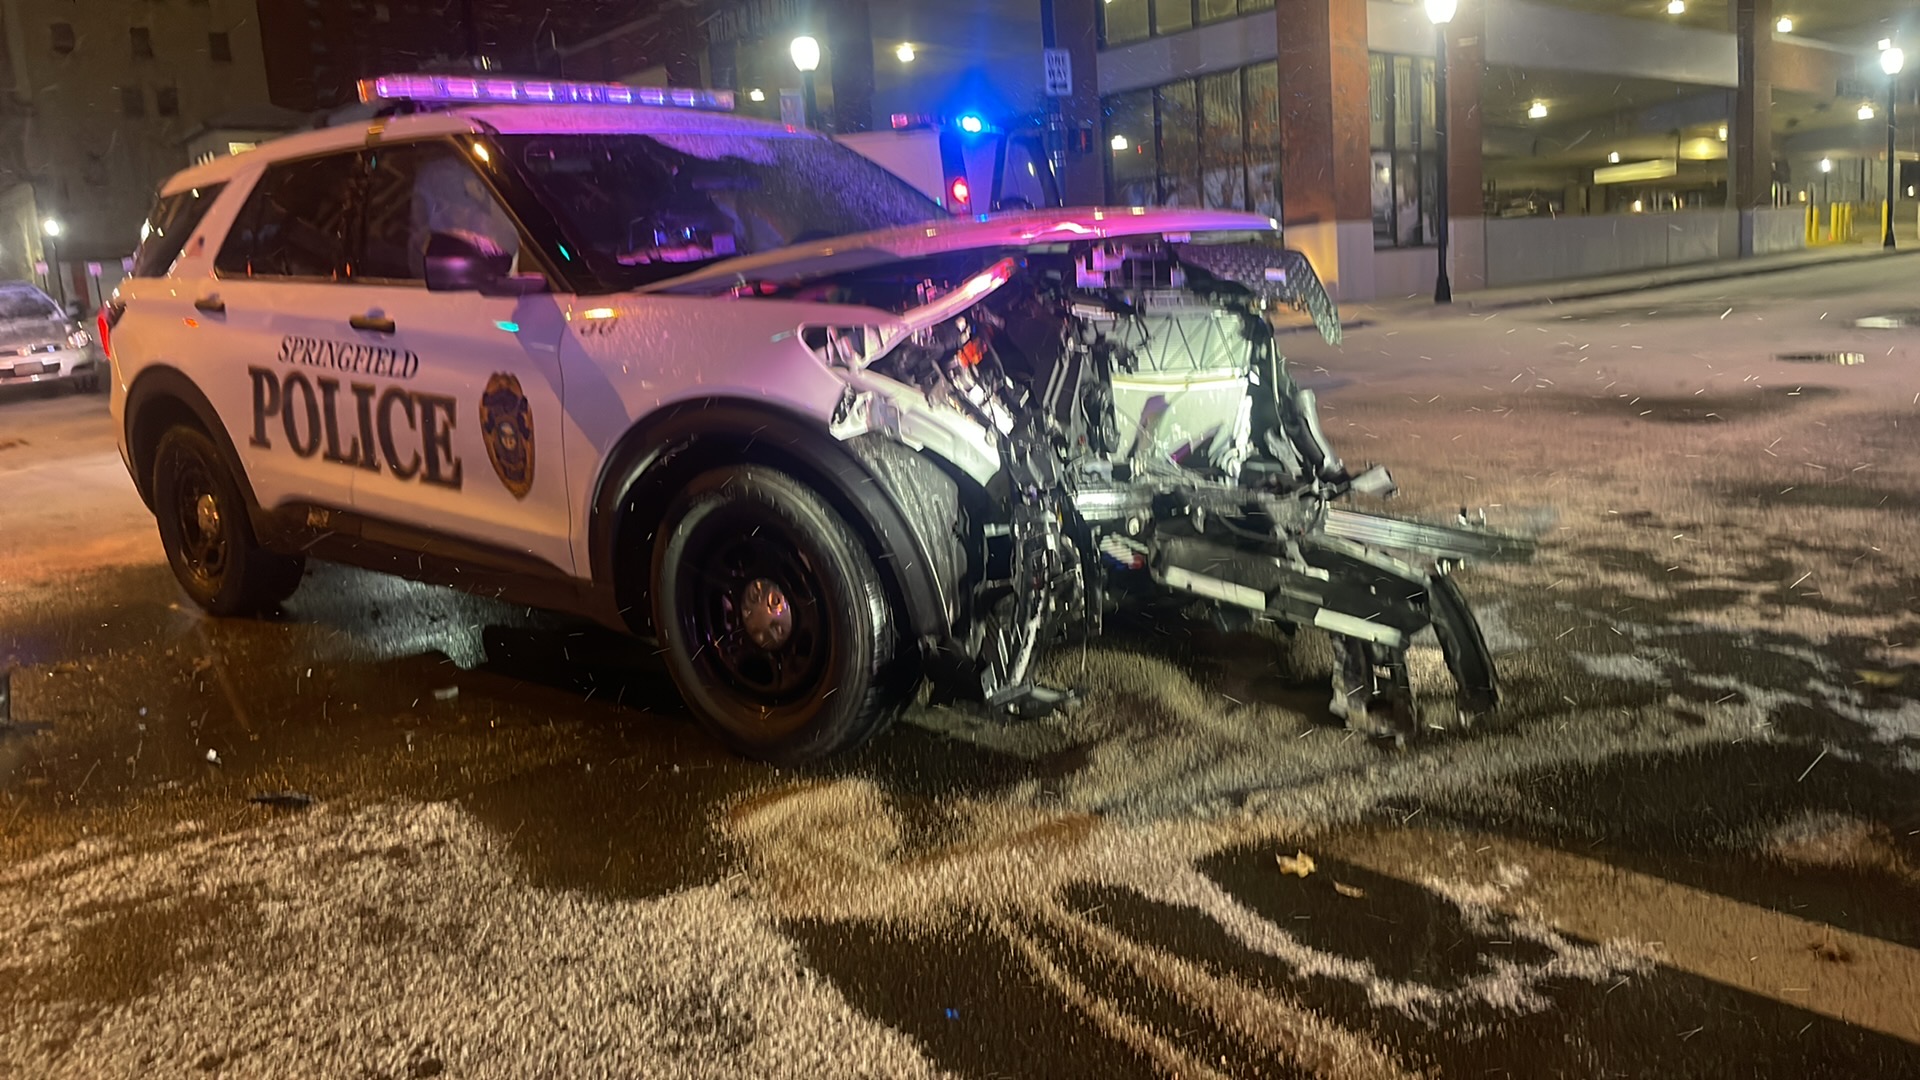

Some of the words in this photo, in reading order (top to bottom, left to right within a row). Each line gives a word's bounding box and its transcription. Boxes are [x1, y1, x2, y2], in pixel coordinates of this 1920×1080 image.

[1048, 67, 1067, 80] WAY
[278, 335, 419, 380] SPRINGFIELD
[248, 364, 463, 492] POLICE
